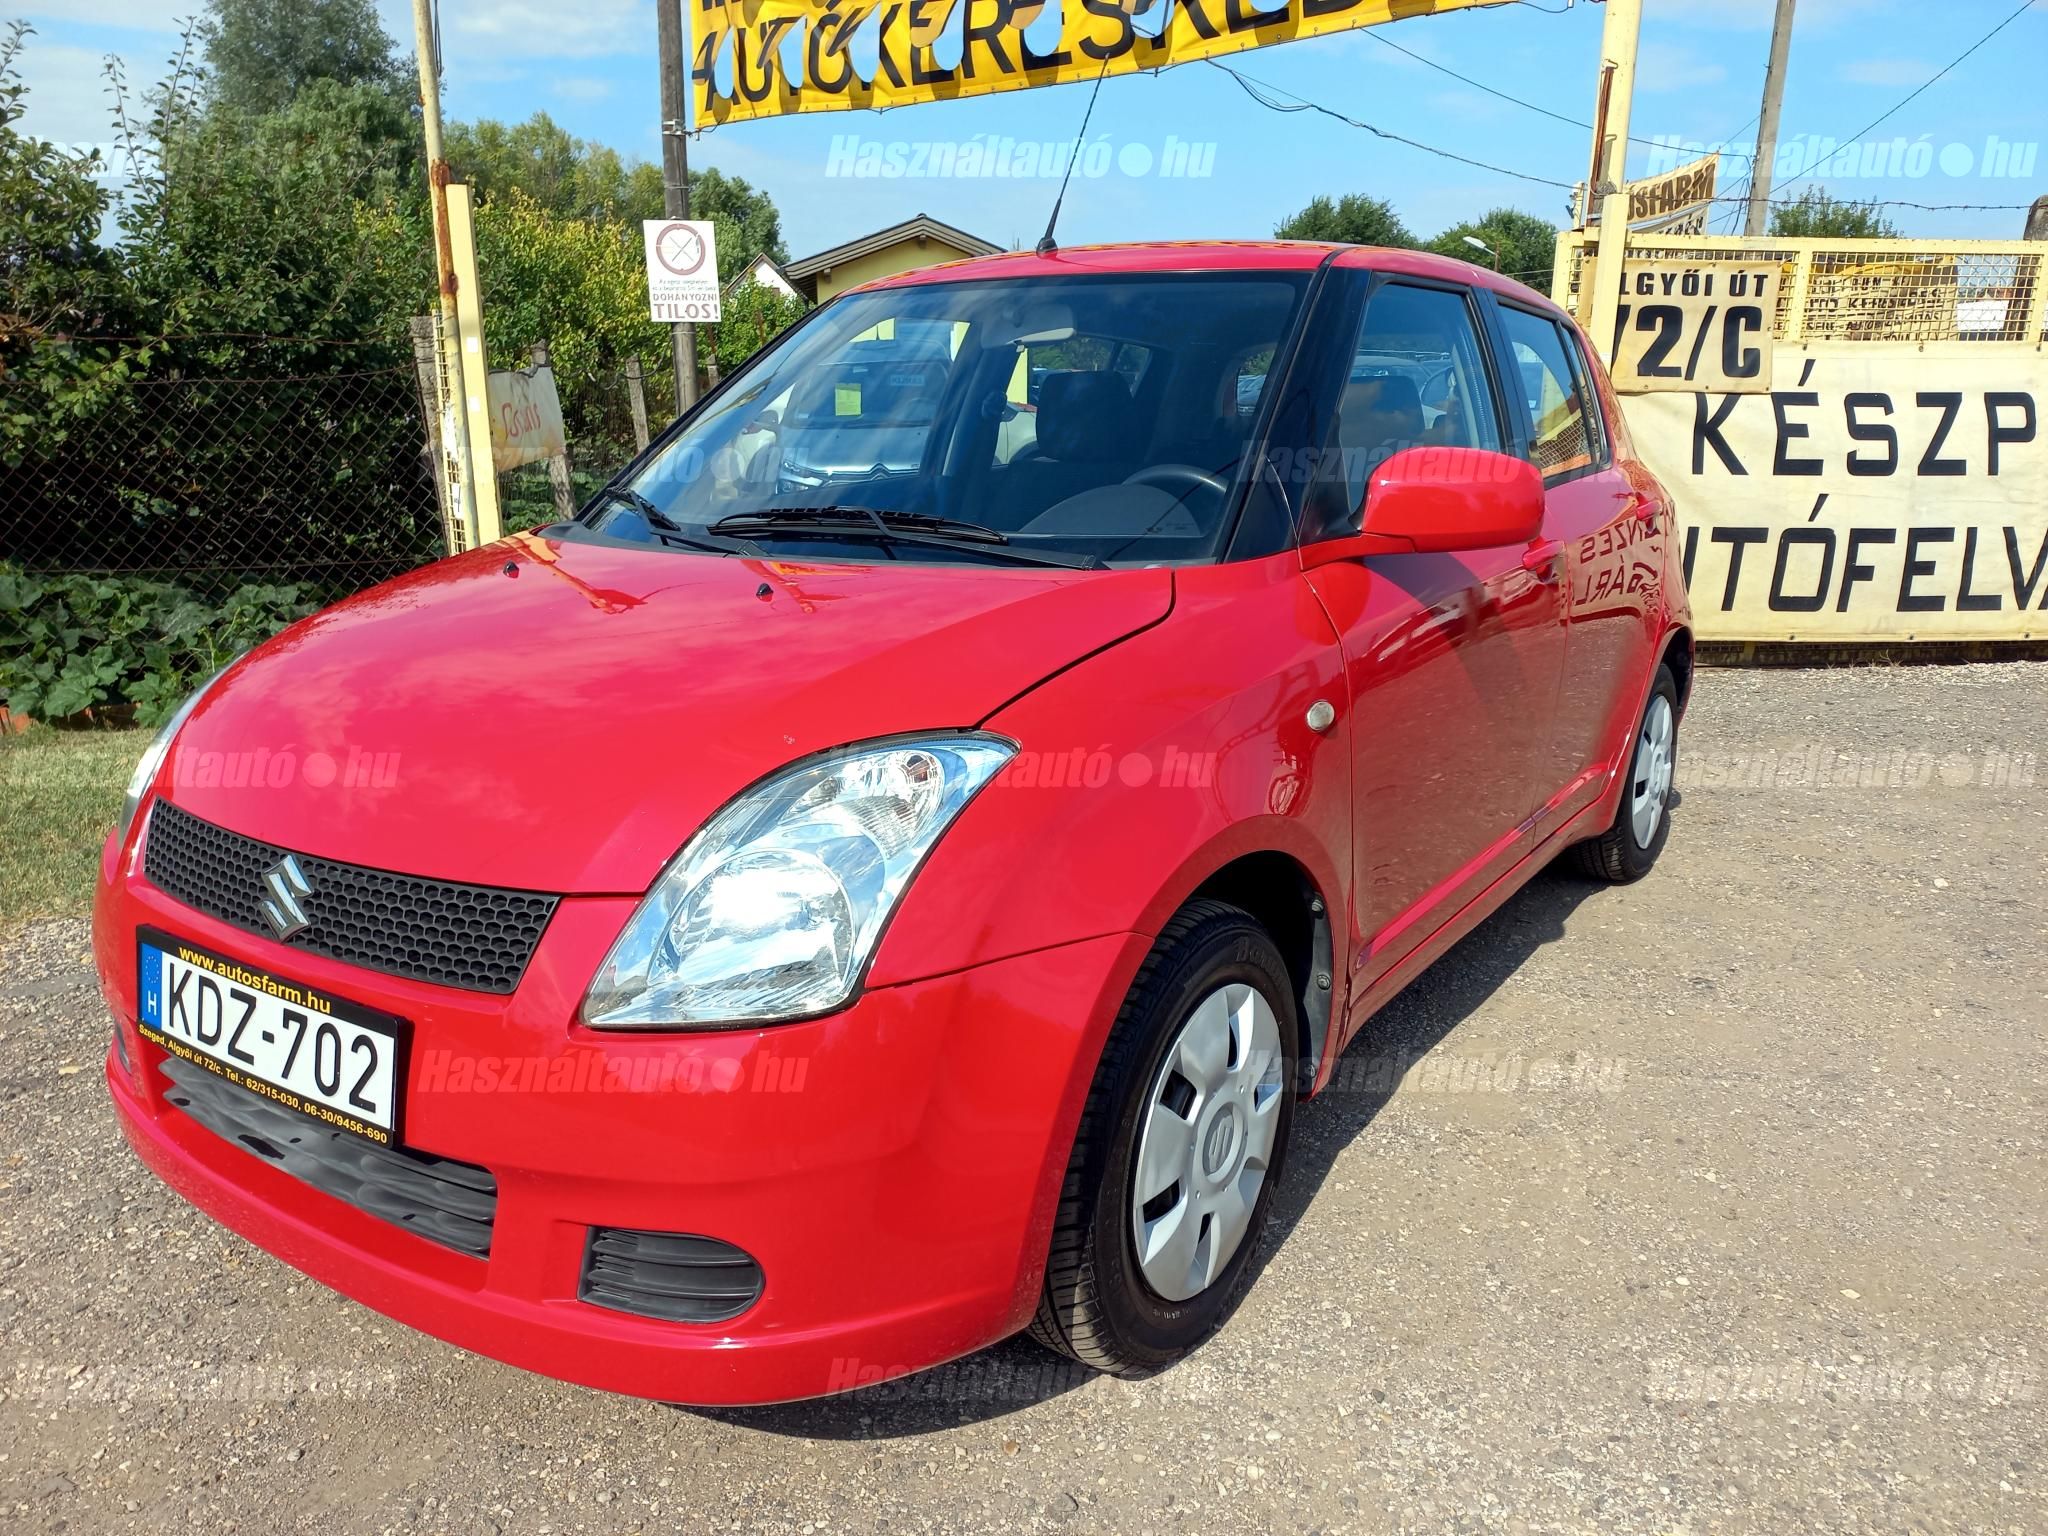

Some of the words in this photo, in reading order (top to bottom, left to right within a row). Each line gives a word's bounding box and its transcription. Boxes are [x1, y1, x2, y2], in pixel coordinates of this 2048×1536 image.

[653, 303, 719, 320] TILOS!
[1620, 269, 1713, 297] LGYŐI
[1729, 270, 1768, 297] ÚT
[1692, 359, 2036, 476] KÉSZP
[1682, 493, 2048, 613] TÓFELV
[147, 989, 157, 1016] H
[179, 947, 331, 1014] www.autosfarm.hu
[139, 1024, 167, 1048] Szeged,
[194, 1053, 203, 1065] út
[246, 1077, 302, 1111] 62/315-030,
[304, 1103, 388, 1144] 06-30/9456-690
[169, 962, 376, 1114] KDZ-702
